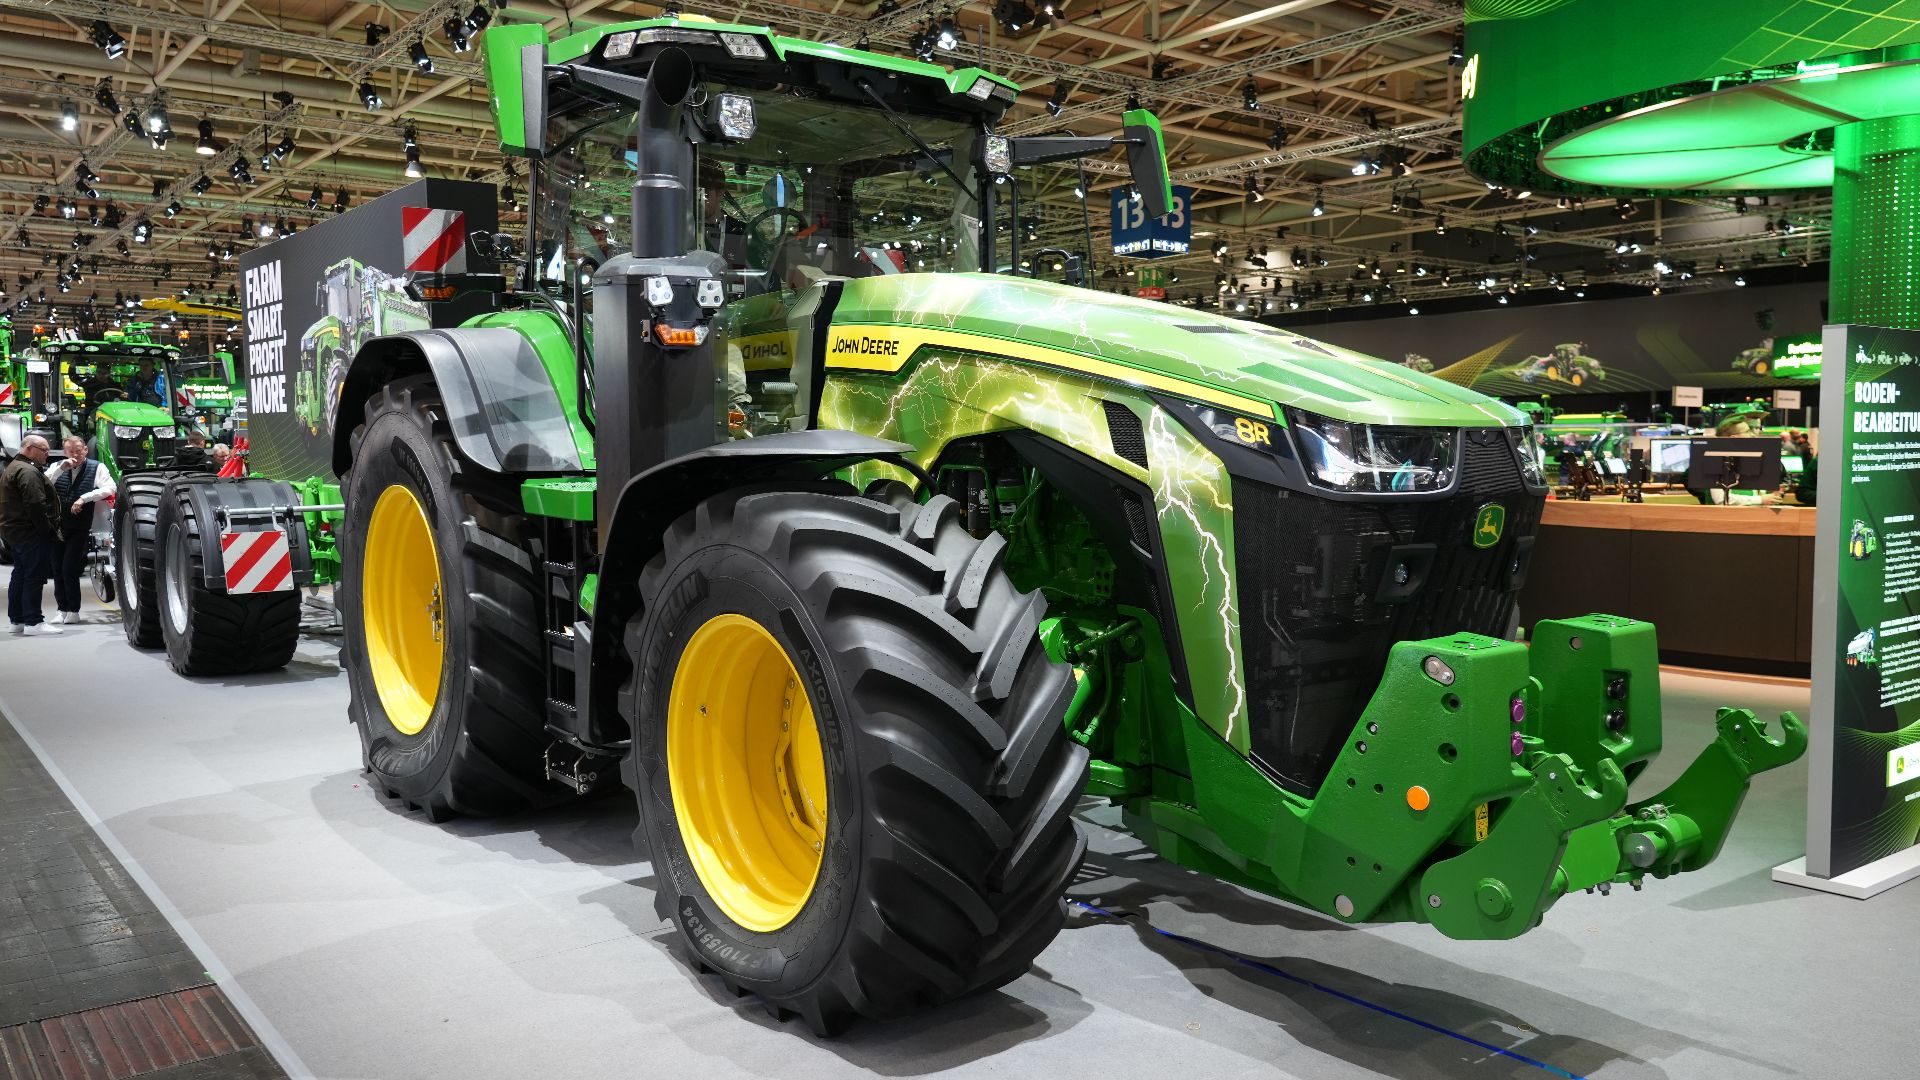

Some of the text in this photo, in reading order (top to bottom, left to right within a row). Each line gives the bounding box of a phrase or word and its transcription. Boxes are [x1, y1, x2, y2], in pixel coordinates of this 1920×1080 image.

[1118, 196, 1145, 230] 13
[245, 259, 283, 309] FARM
[248, 303, 287, 346] SMART,
[249, 339, 284, 376] PROFIT
[832, 336, 900, 356] JOHN DEERE
[250, 374, 288, 414] MORE
[1854, 381, 1901, 404] BODEN-
[1234, 417, 1271, 446] 8R
[1853, 411, 1920, 433] BEARBEITU
